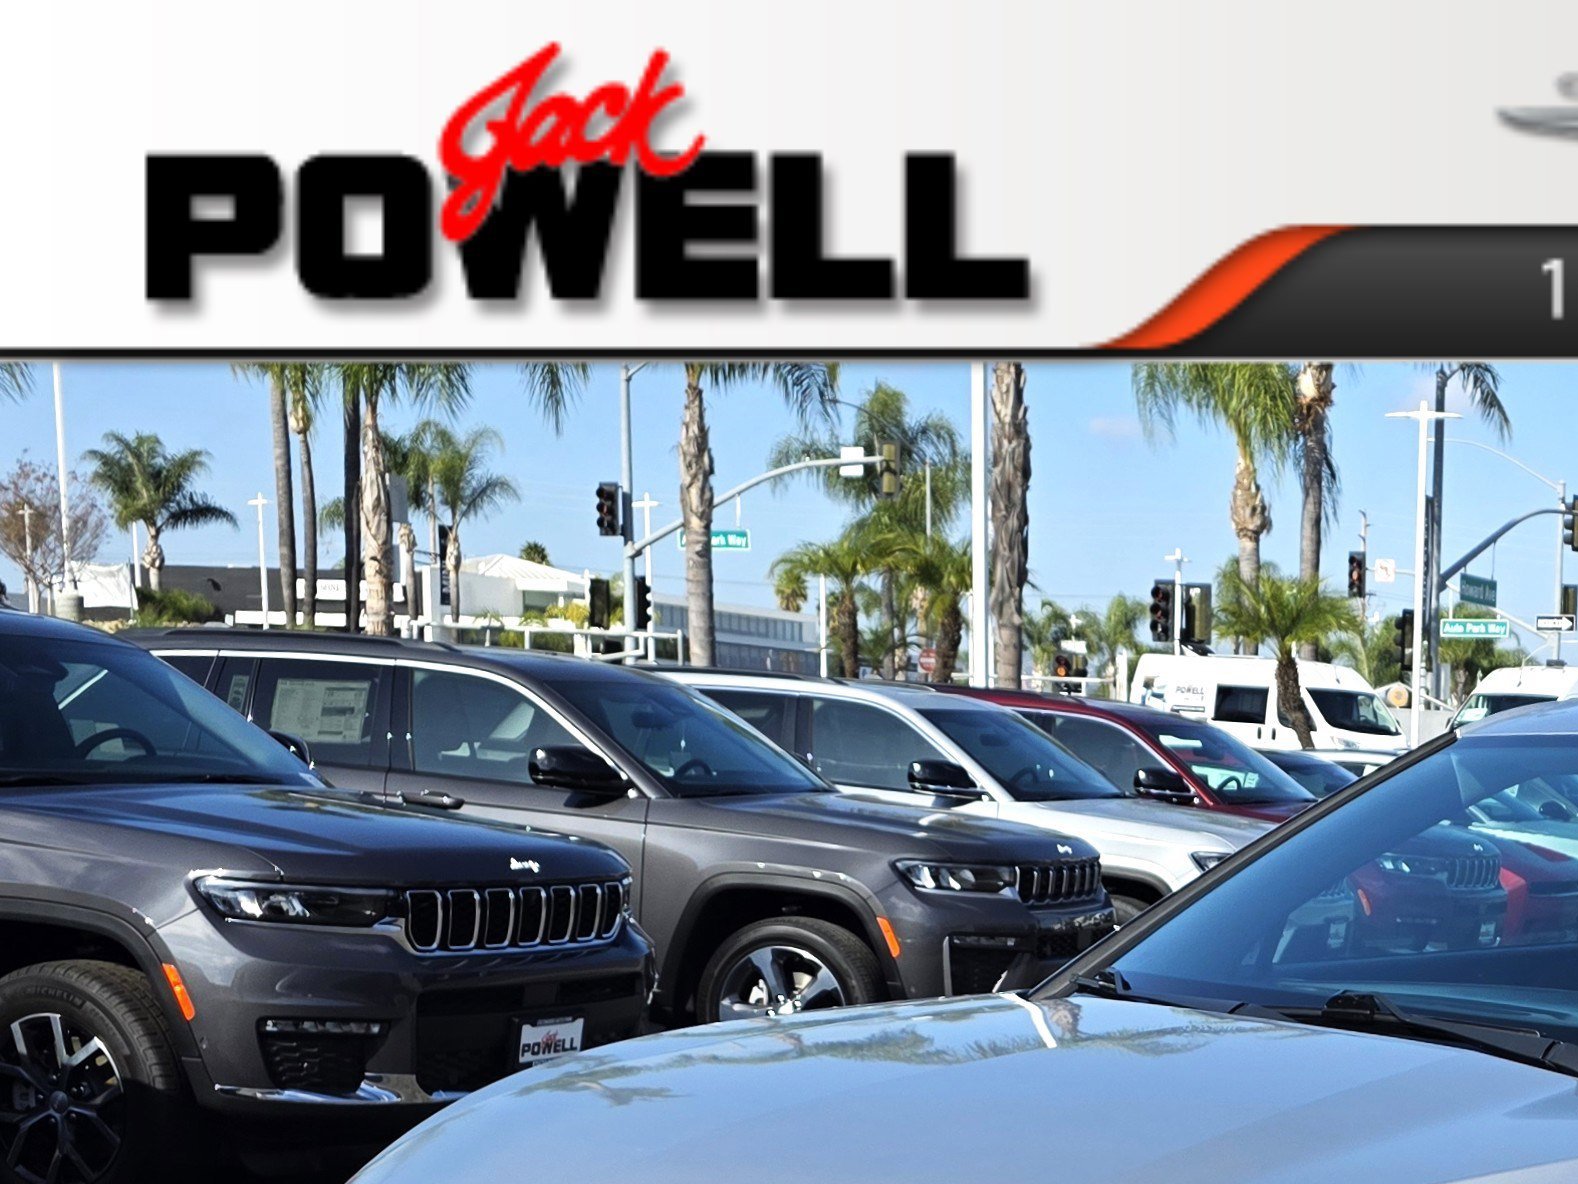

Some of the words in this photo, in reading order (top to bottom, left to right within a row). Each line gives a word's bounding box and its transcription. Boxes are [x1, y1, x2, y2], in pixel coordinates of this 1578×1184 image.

[727, 534, 747, 547] Way
[1443, 622, 1465, 633] Auto
[1466, 622, 1487, 633] Park
[1488, 622, 1506, 635] Way
[1176, 684, 1205, 695] POWELL
[520, 1037, 578, 1058] POWELL
